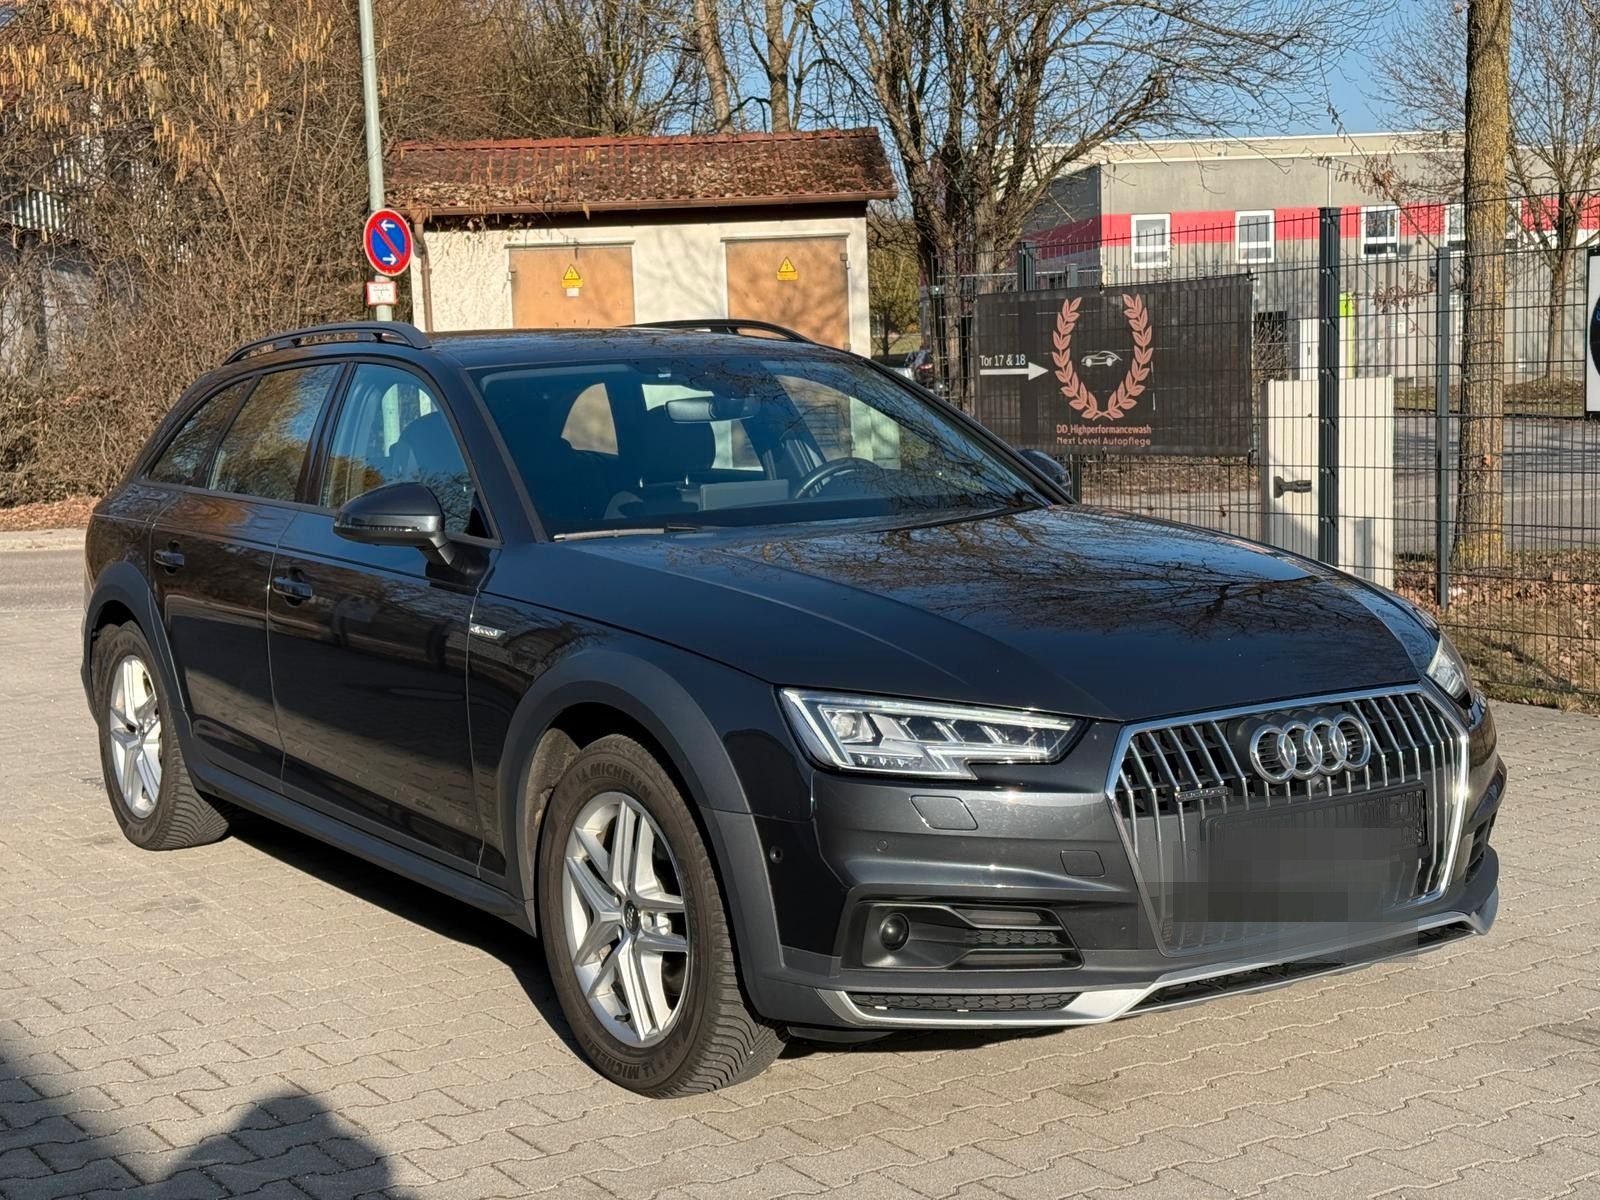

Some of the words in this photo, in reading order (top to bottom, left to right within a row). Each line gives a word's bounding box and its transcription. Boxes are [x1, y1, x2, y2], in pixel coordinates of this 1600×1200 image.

[979, 355, 992, 366] Tor
[994, 354, 1004, 366] 17
[1006, 354, 1013, 366] &
[1015, 354, 1026, 366] 18
[1056, 436, 1075, 445] Next
[1078, 436, 1100, 445] Level
[1102, 436, 1151, 447] Autopflege
[590, 762, 652, 798] MICHELIN
